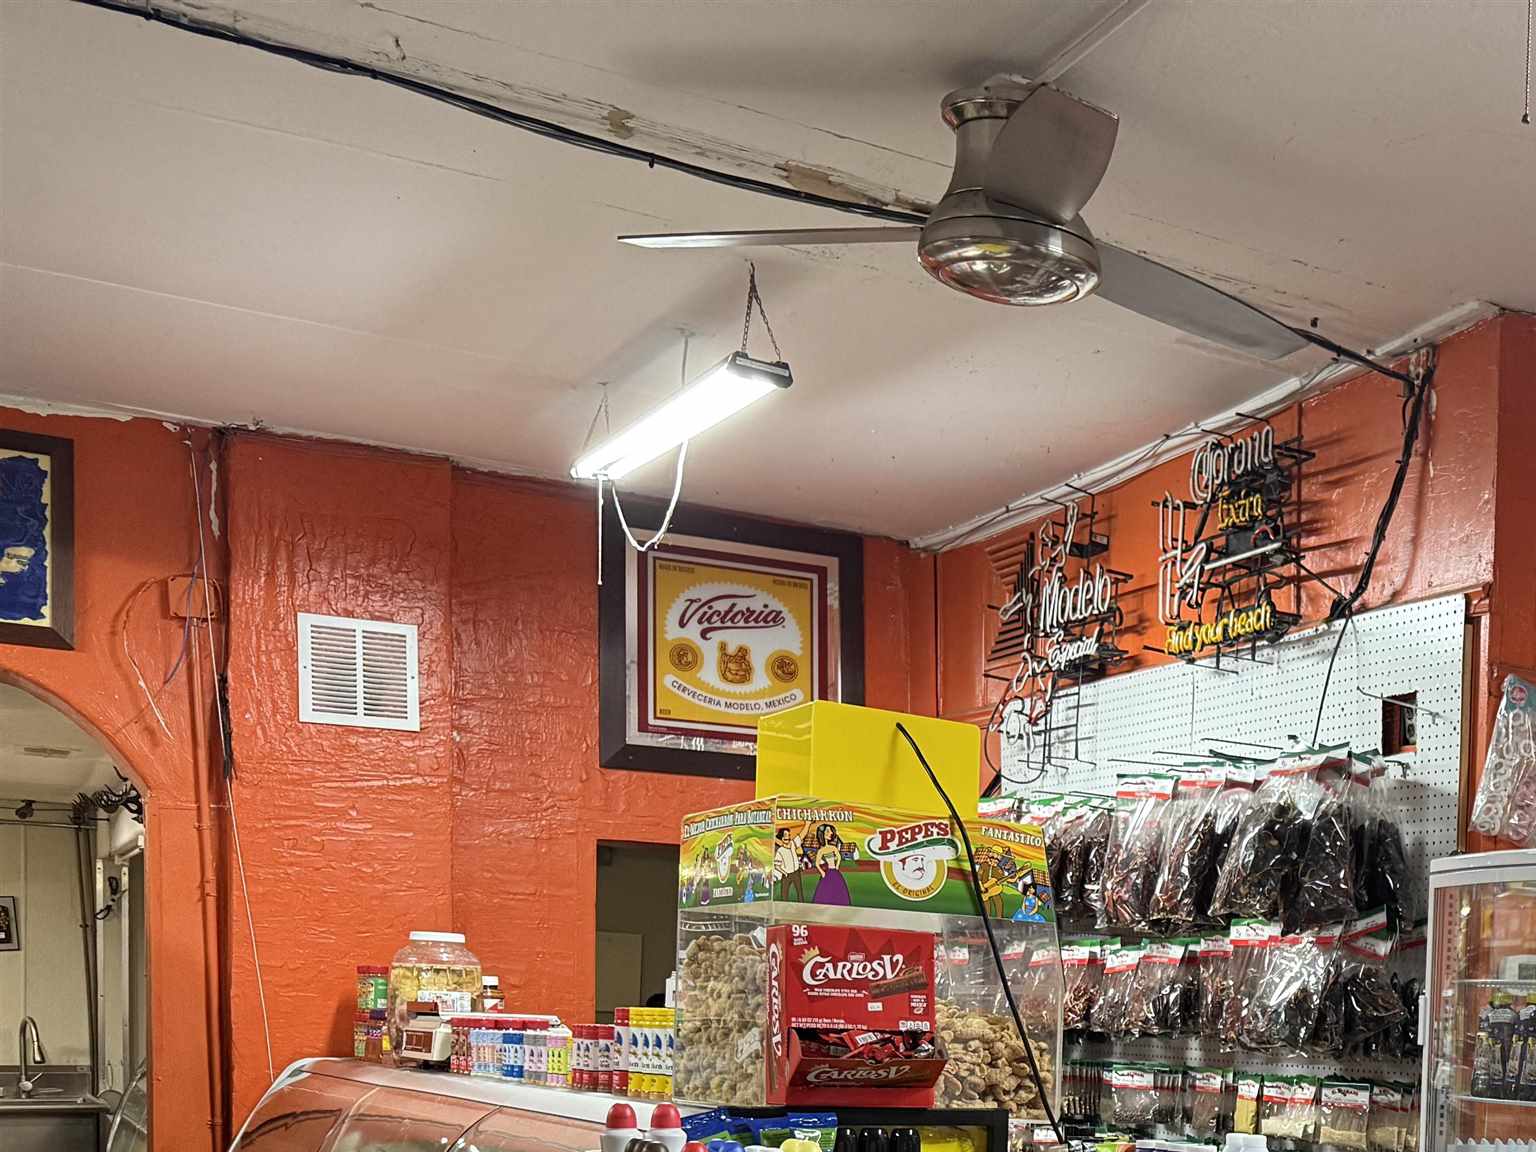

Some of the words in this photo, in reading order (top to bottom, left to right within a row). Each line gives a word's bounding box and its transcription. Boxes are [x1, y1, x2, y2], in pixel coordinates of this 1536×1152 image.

[1191, 426, 1274, 504] Corona
[1040, 563, 1112, 632] Modelo
[678, 593, 786, 641] Victoria
[671, 679, 723, 707] CERVECERIA
[765, 693, 798, 710] MEXICO
[776, 806, 854, 823] CHICHARRÓN
[877, 821, 950, 851] PEPE'S
[981, 825, 1043, 847] FANTASTICO
[791, 925, 808, 937] 96
